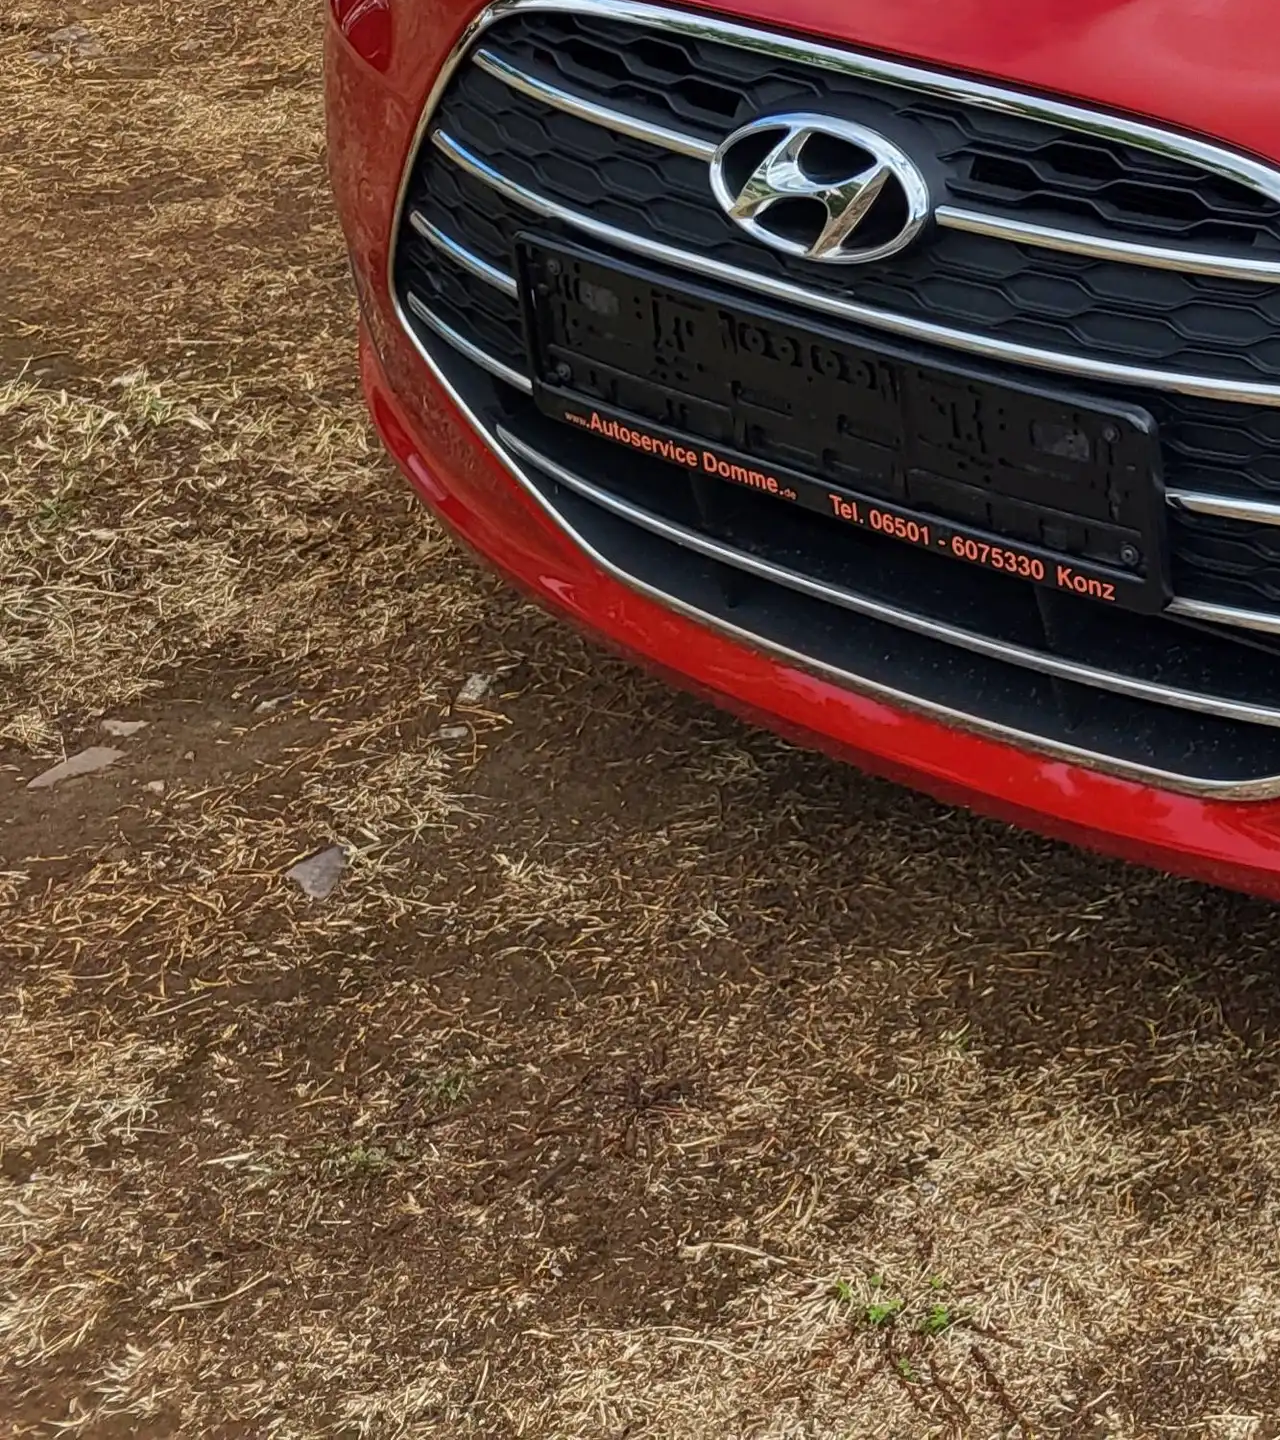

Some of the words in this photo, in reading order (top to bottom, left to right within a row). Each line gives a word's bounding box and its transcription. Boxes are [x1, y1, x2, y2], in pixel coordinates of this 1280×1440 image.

[702, 450, 797, 501] Domme.de
[828, 493, 865, 525] Tel.
[868, 509, 931, 546] 06501
[951, 535, 1045, 581] 6075330
[1056, 564, 1116, 602] Konz
